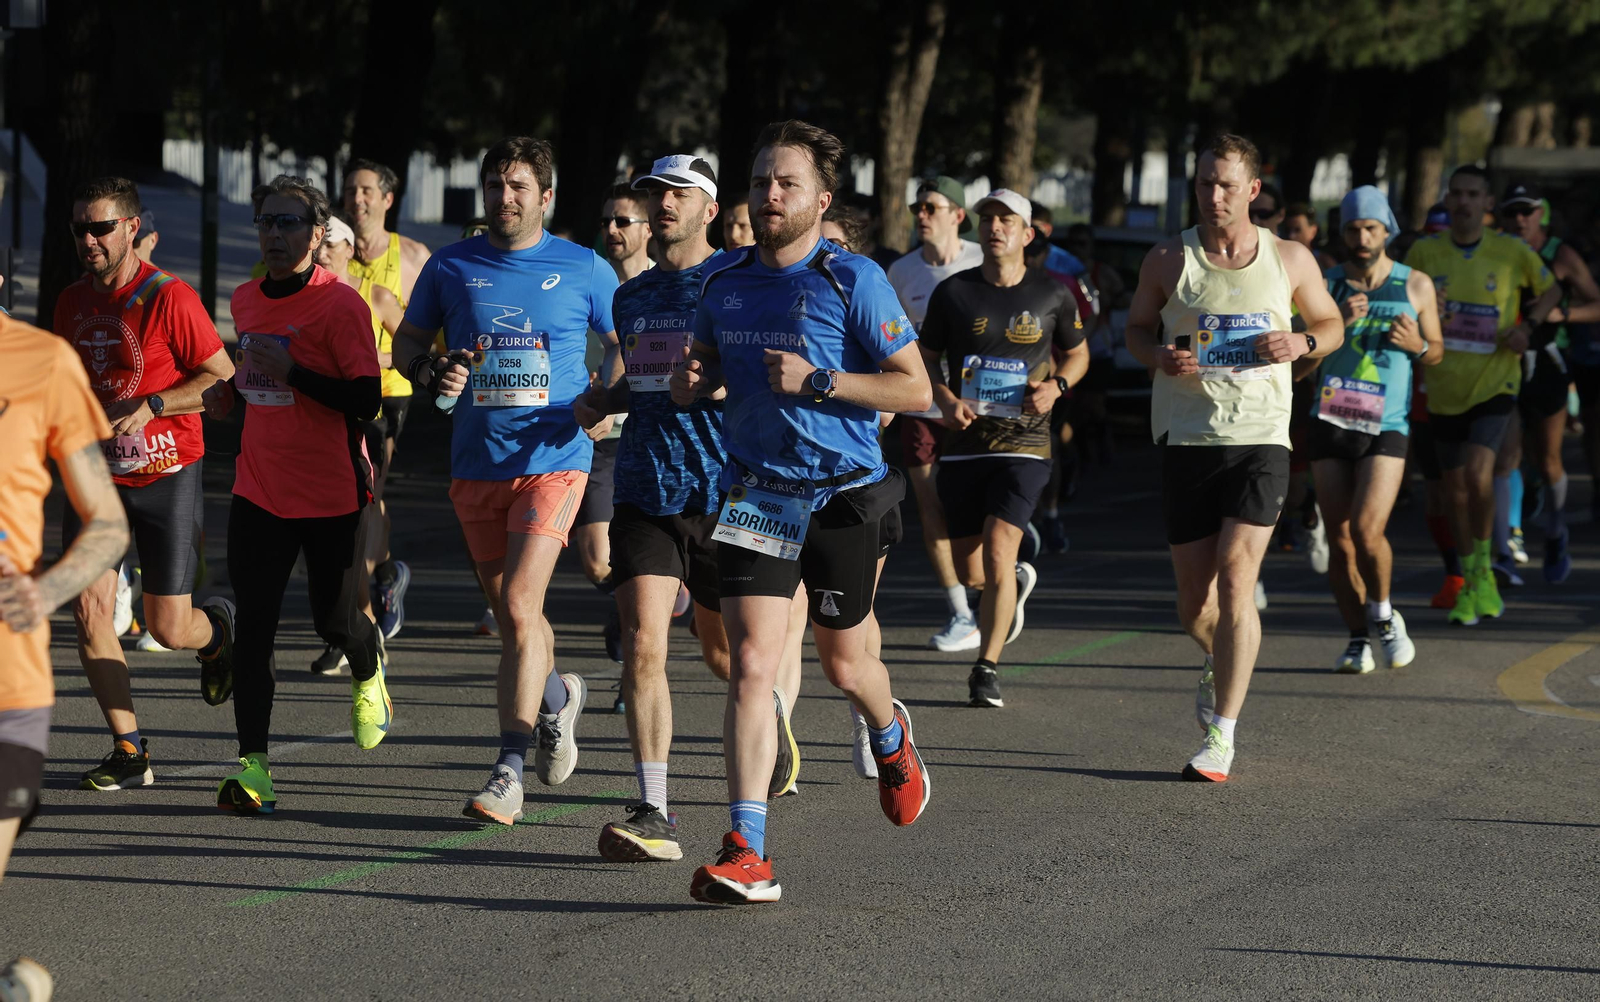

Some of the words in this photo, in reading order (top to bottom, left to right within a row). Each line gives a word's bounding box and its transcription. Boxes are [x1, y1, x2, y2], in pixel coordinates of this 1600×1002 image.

[649, 319, 686, 329] ZURICH
[1224, 318, 1262, 328] ZURICH
[497, 337, 541, 347] ZURICH
[722, 331, 808, 347] TROTASIERRA
[649, 341, 667, 352] 9281
[498, 358, 522, 368] 5258
[625, 363, 640, 374] LES
[984, 360, 1020, 371] ZURICH
[472, 373, 549, 388] FRANCISCO
[984, 377, 1003, 387] 5745
[1344, 380, 1380, 393] ZURICH
[975, 387, 1010, 403] TIAGO
[103, 445, 140, 459] ACLA
[762, 479, 805, 495] ZURICH
[758, 500, 783, 515] 6686
[726, 508, 801, 540] SORIMAN
